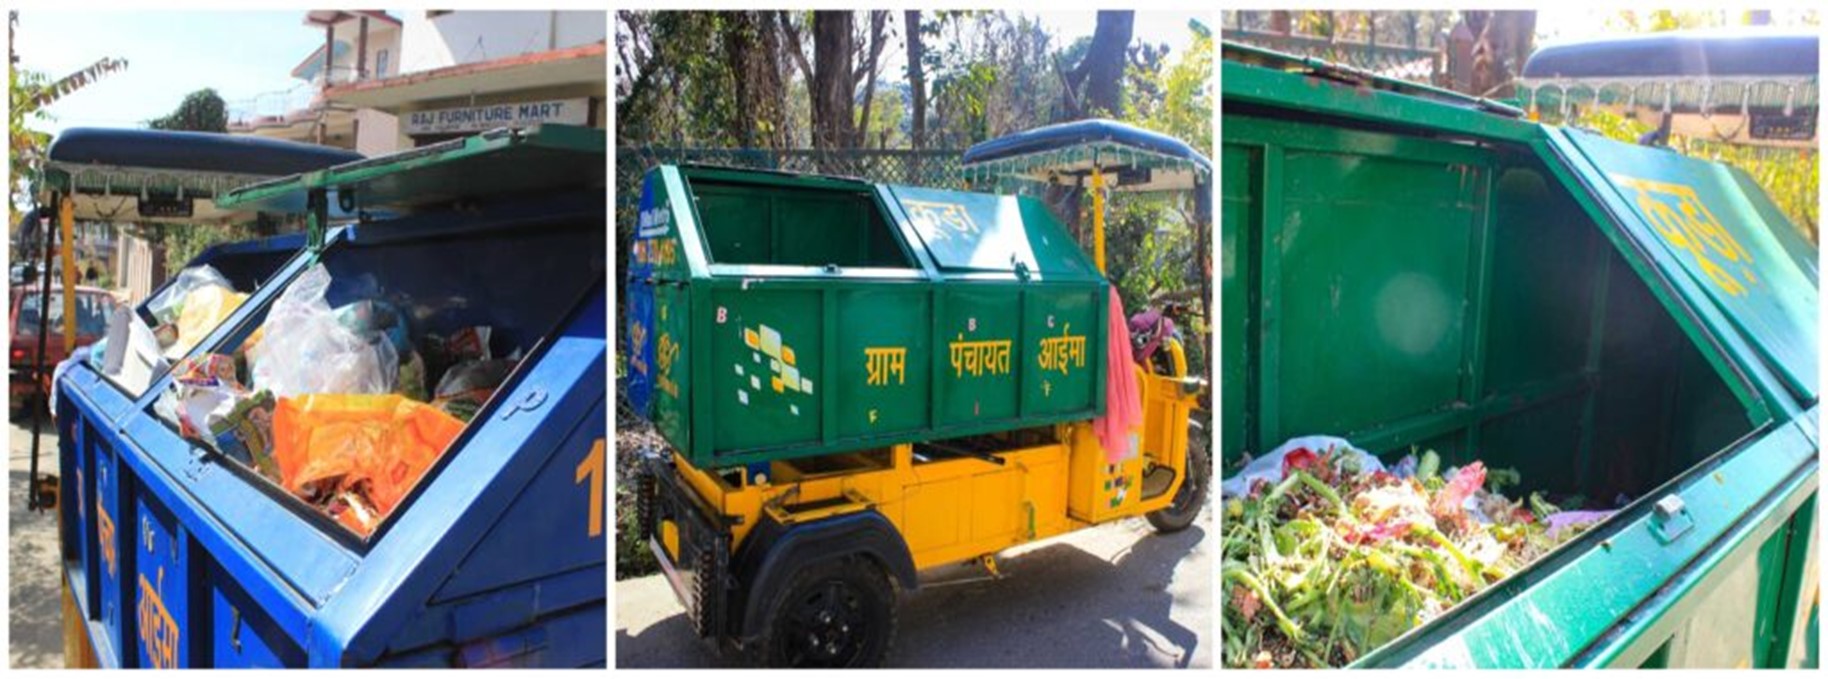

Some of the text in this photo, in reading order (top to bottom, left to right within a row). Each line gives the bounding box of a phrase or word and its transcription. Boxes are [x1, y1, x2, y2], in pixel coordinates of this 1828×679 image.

[411, 112, 434, 126] RAJ
[438, 107, 513, 124] FURNITURE
[518, 102, 564, 119] MART
[716, 305, 728, 324] B
[864, 322, 1086, 386] ग्राम पंचायत आईमा
